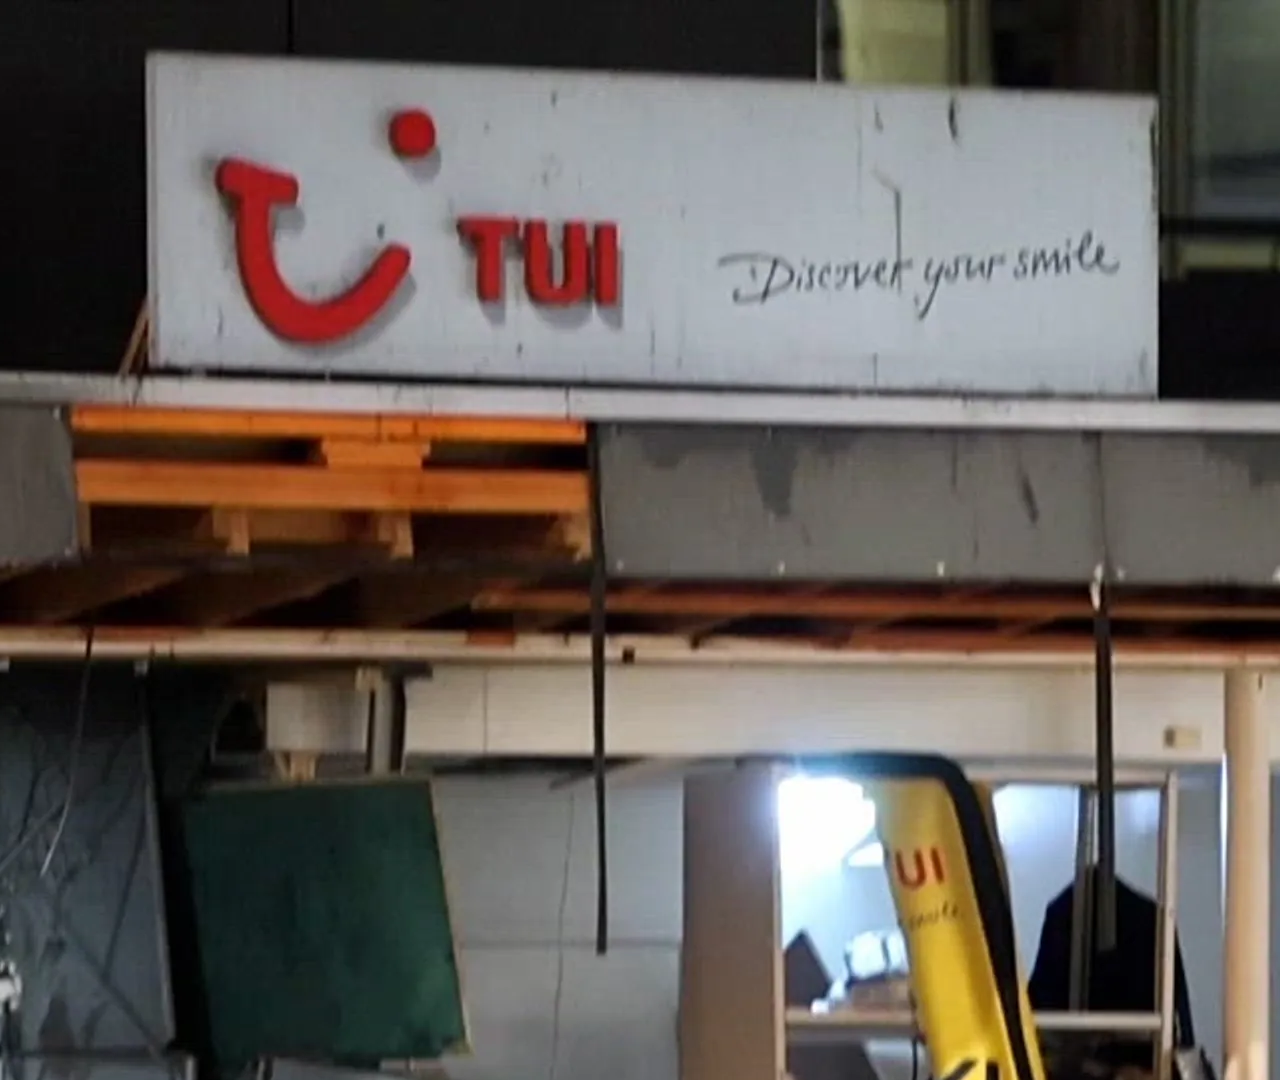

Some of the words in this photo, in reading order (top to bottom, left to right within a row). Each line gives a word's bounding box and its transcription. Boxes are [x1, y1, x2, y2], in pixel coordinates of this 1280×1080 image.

[456, 216, 619, 307] TUI
[718, 251, 913, 303] Discover
[914, 254, 1005, 320] your
[1014, 229, 1120, 279] smile
